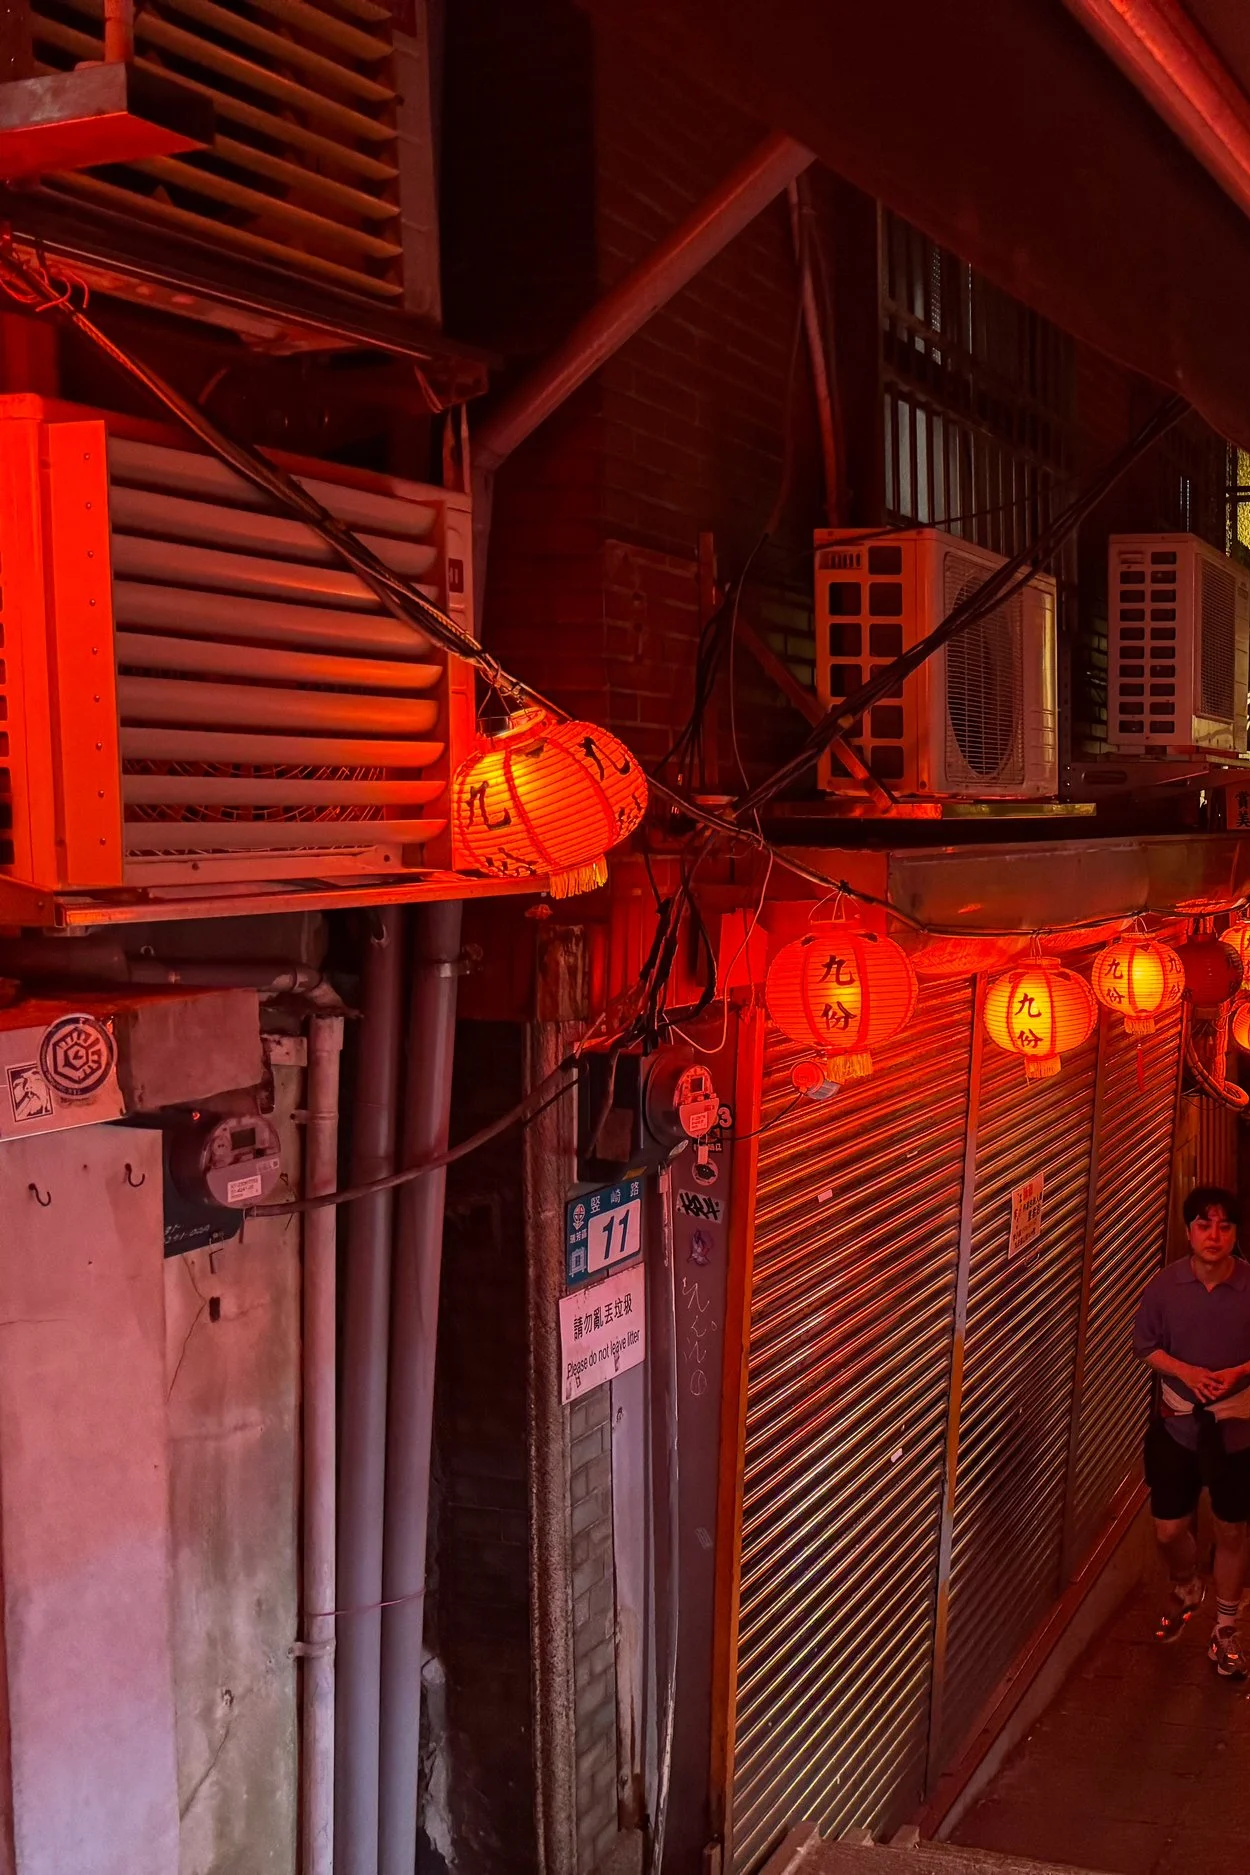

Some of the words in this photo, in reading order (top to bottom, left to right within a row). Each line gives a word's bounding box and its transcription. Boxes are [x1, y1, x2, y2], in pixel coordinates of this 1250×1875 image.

[818, 954, 857, 1031] 九份
[1104, 958, 1126, 1005] 九份
[1014, 994, 1044, 1048] 九份
[602, 1209, 630, 1260] 11
[566, 1357, 589, 1379] Please
[588, 1350, 598, 1366] do
[598, 1346, 609, 1362] not
[610, 1338, 627, 1356] leave
[627, 1330, 641, 1346] litter
